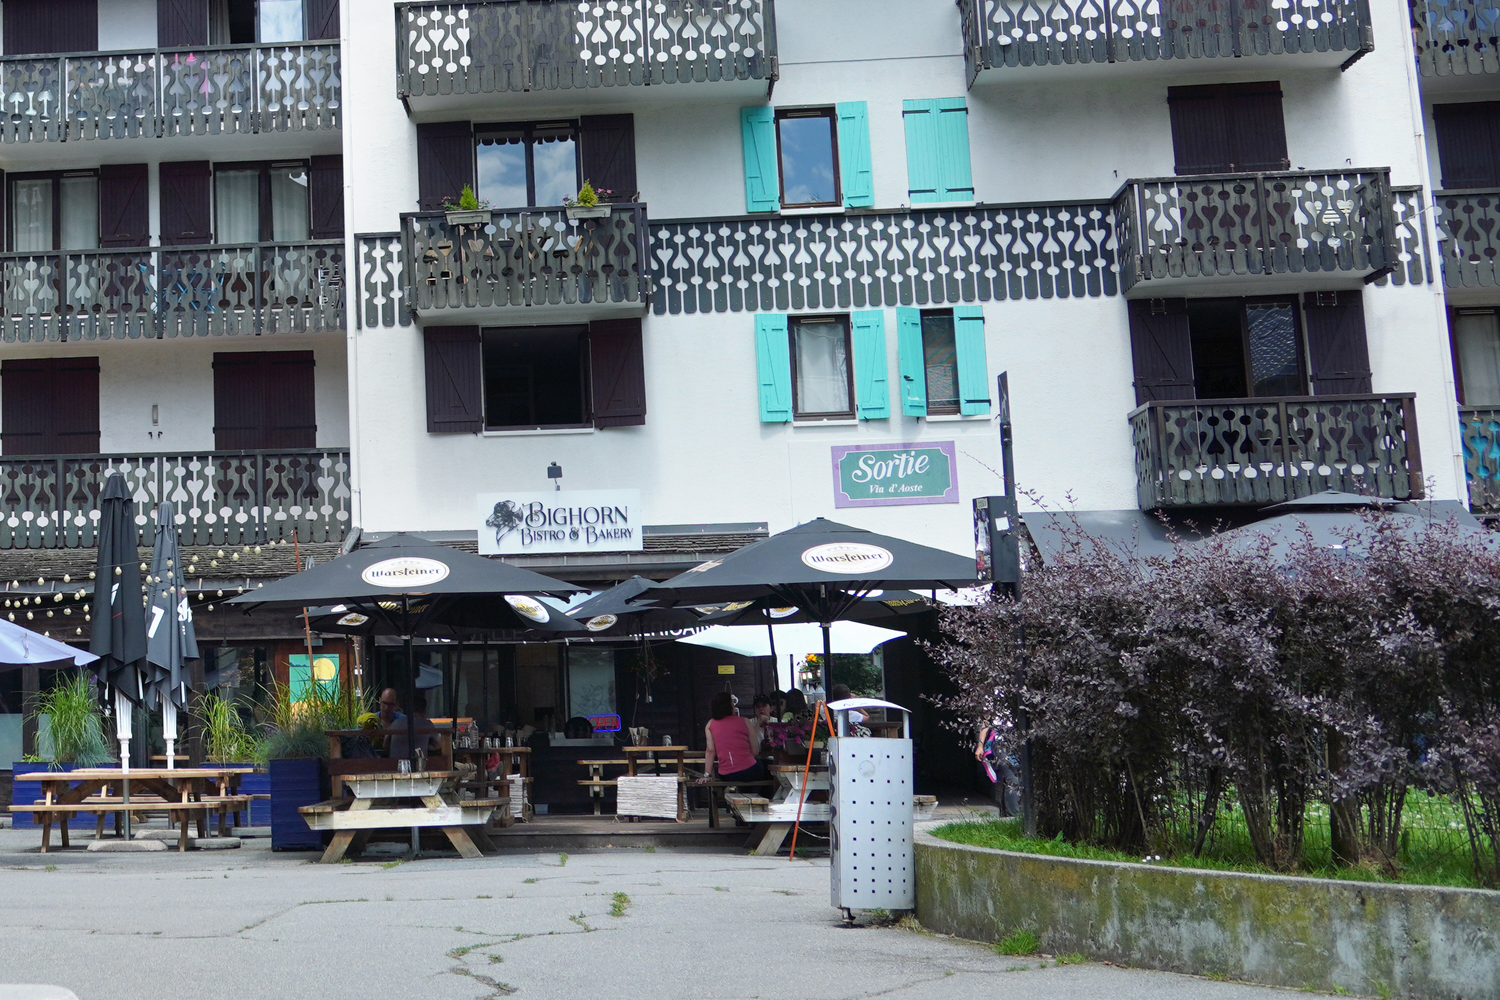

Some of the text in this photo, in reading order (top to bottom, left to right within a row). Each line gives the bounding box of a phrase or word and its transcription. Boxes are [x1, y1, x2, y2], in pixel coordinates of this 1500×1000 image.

[851, 450, 930, 483] Sortie
[869, 484, 884, 494] Via
[522, 501, 628, 528] BIGHORN
[517, 525, 634, 546] BISTRO & BAKERY
[810, 553, 884, 563] Warsteiner
[371, 566, 441, 579] Warsteiner
[589, 716, 620, 730] OPEN
